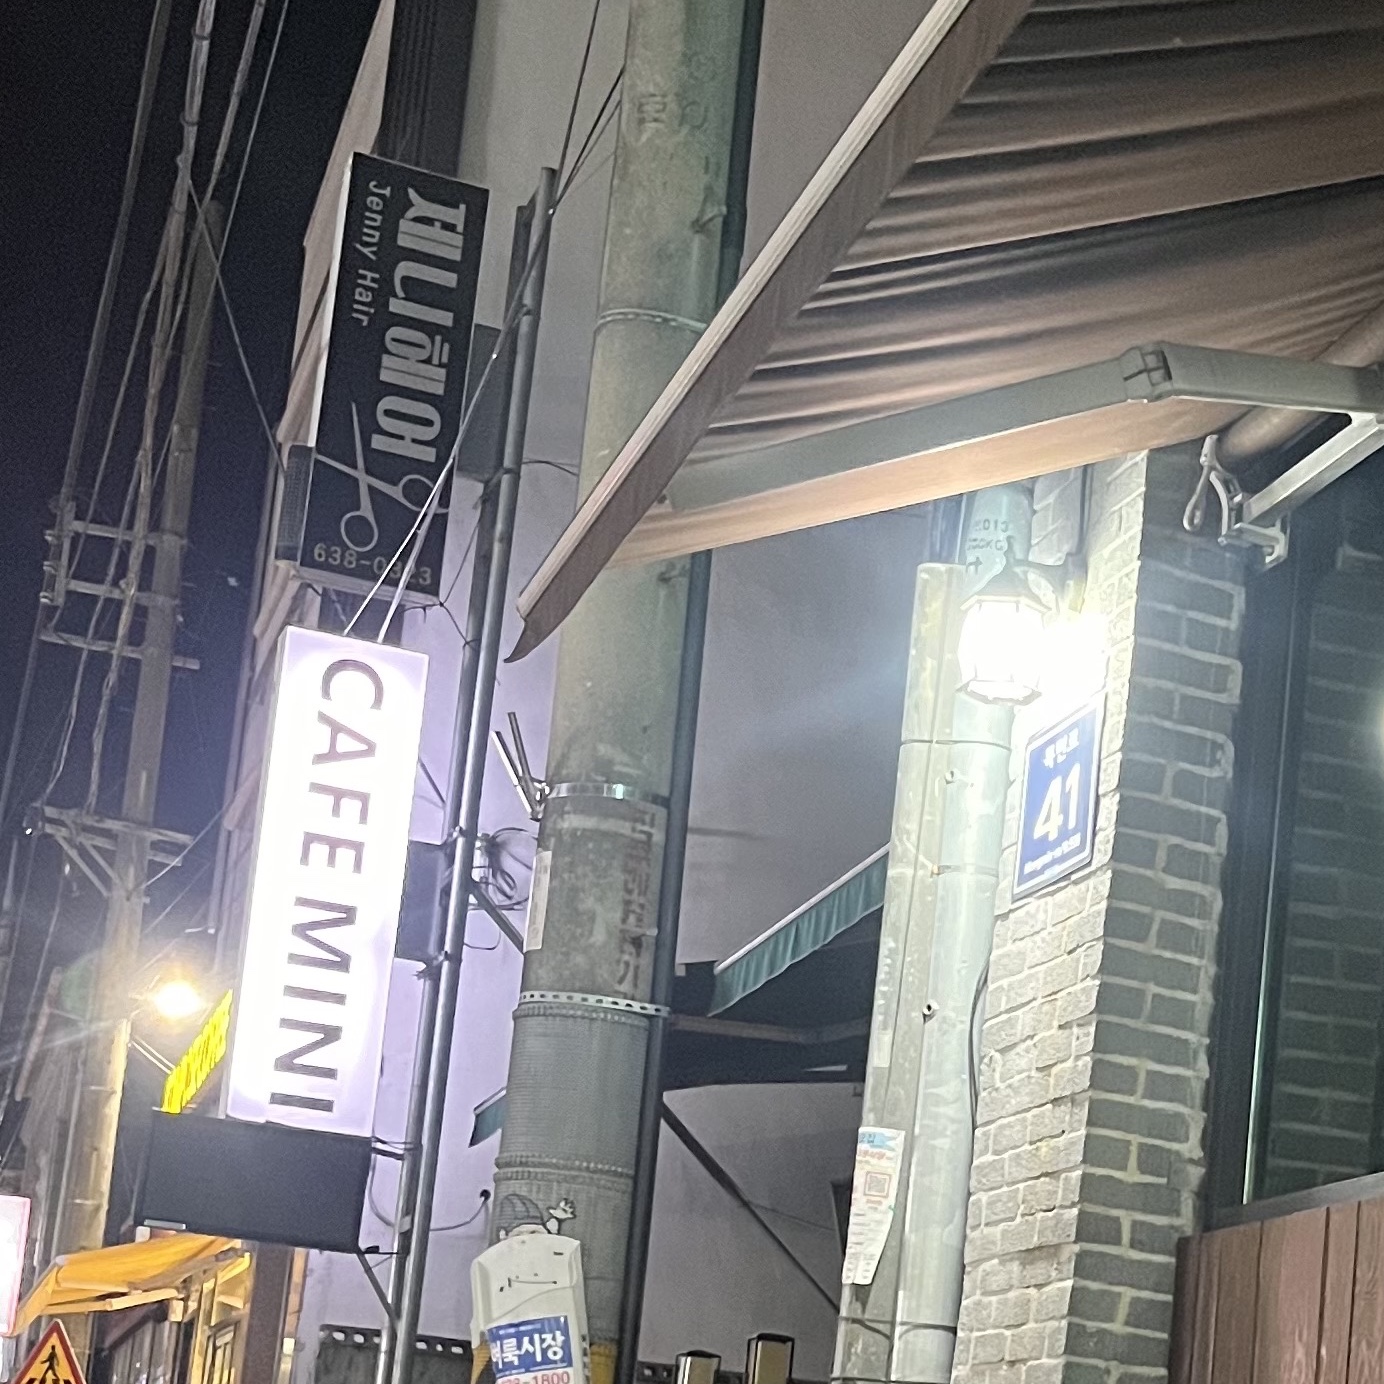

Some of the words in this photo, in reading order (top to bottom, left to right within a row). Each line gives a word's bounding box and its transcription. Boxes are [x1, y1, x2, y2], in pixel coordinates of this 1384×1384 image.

[354, 180, 391, 261] Jenny
[352, 269, 380, 326] Hair
[371, 187, 466, 462] 제니헤어
[314, 543, 431, 585] 638-033
[300, 659, 384, 875] CAFE
[1033, 762, 1081, 842] 41
[269, 896, 358, 1113] MINI
